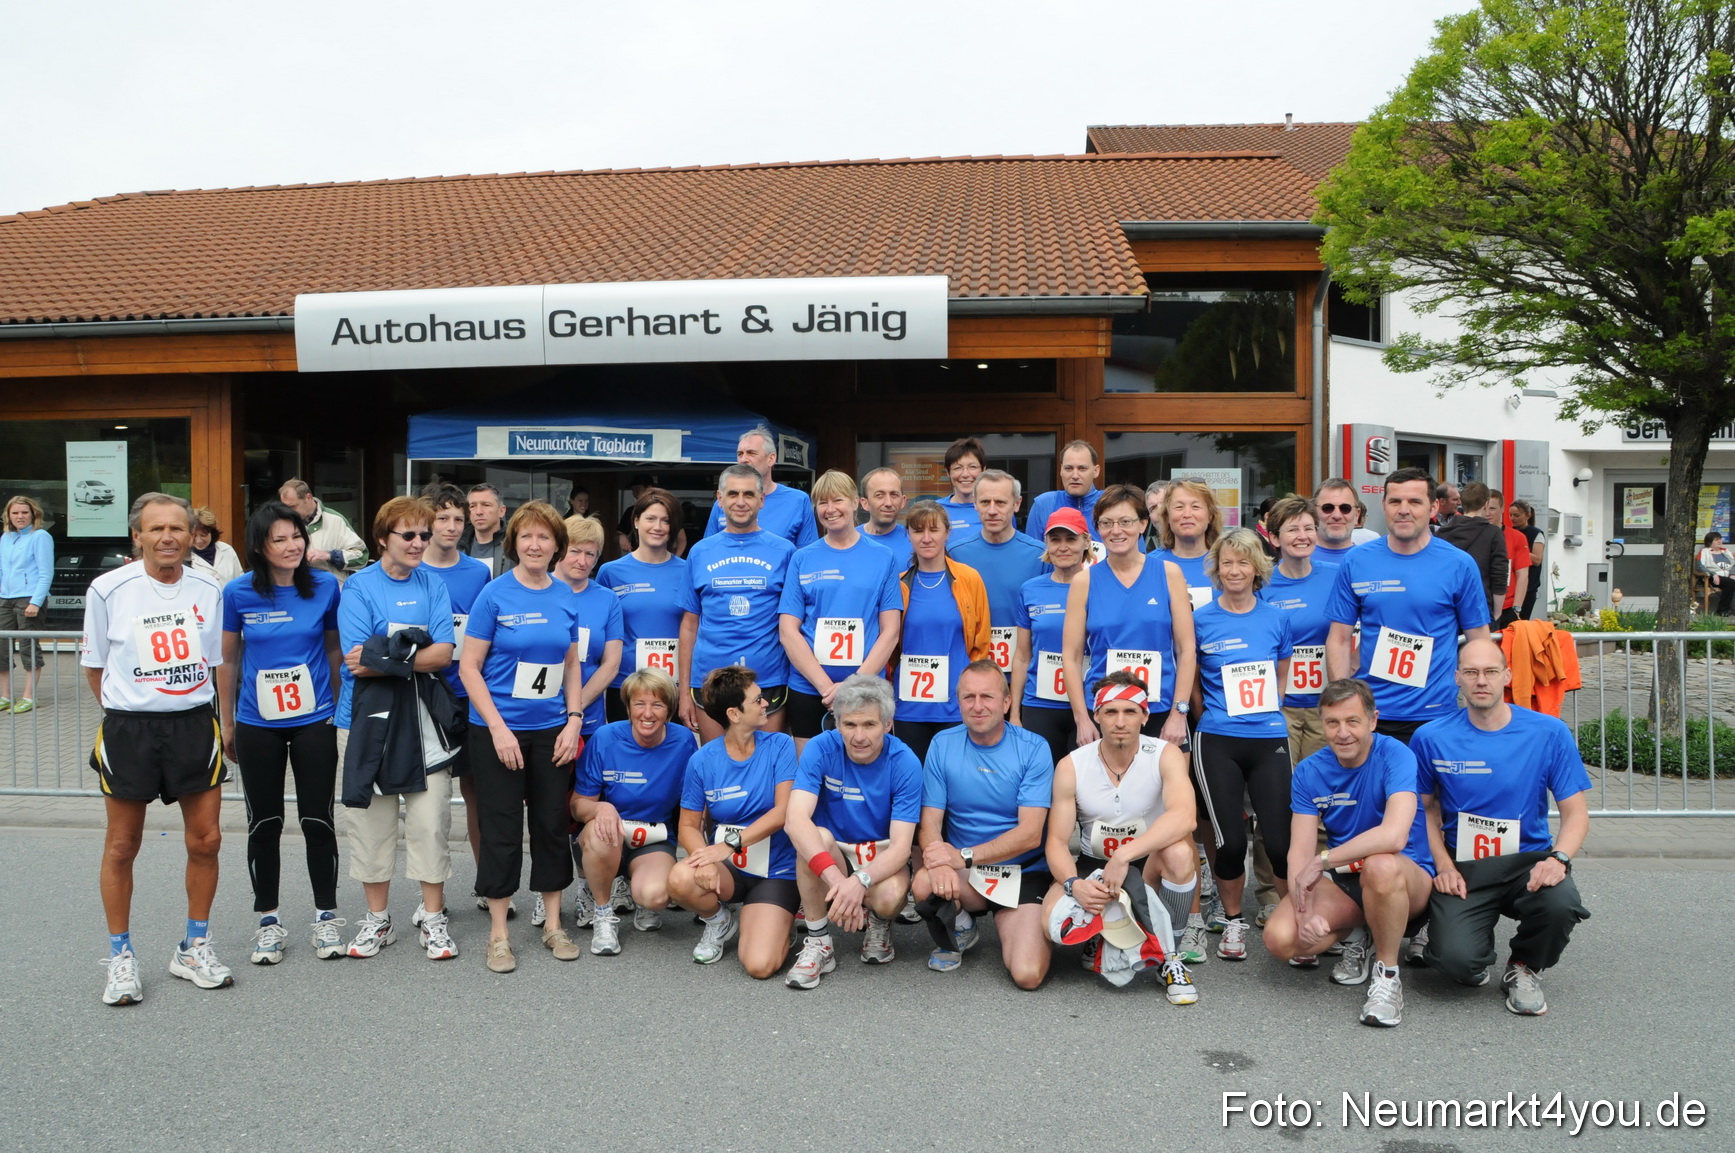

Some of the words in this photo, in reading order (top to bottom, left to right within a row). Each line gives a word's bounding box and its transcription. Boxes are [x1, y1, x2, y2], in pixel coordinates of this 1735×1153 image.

[331, 314, 527, 346] Autohaus
[548, 305, 722, 338] Gerhart
[741, 303, 774, 334] &
[792, 301, 908, 341] Jänig
[515, 435, 590, 452] Neumarkter
[591, 436, 646, 455] Tagblatt
[1361, 485, 1385, 494] SE
[707, 556, 773, 572] funrunners
[143, 614, 173, 626] MEYER
[150, 628, 190, 663] 86
[830, 632, 853, 660] 21
[1388, 632, 1413, 644] MEYER
[648, 652, 674, 677] 65
[1231, 665, 1256, 674] MEYER
[1293, 660, 1322, 689] 55
[1388, 647, 1416, 679] 16
[264, 672, 289, 680] MEYER
[531, 666, 548, 694] 4
[910, 671, 934, 698] 72
[272, 682, 301, 713] 13
[1238, 677, 1265, 709] 67
[1100, 825, 1126, 833] MEYER
[1468, 816, 1495, 827] MEYER
[630, 827, 647, 848] 9
[1474, 834, 1501, 861] 61
[984, 878, 998, 896] 7
